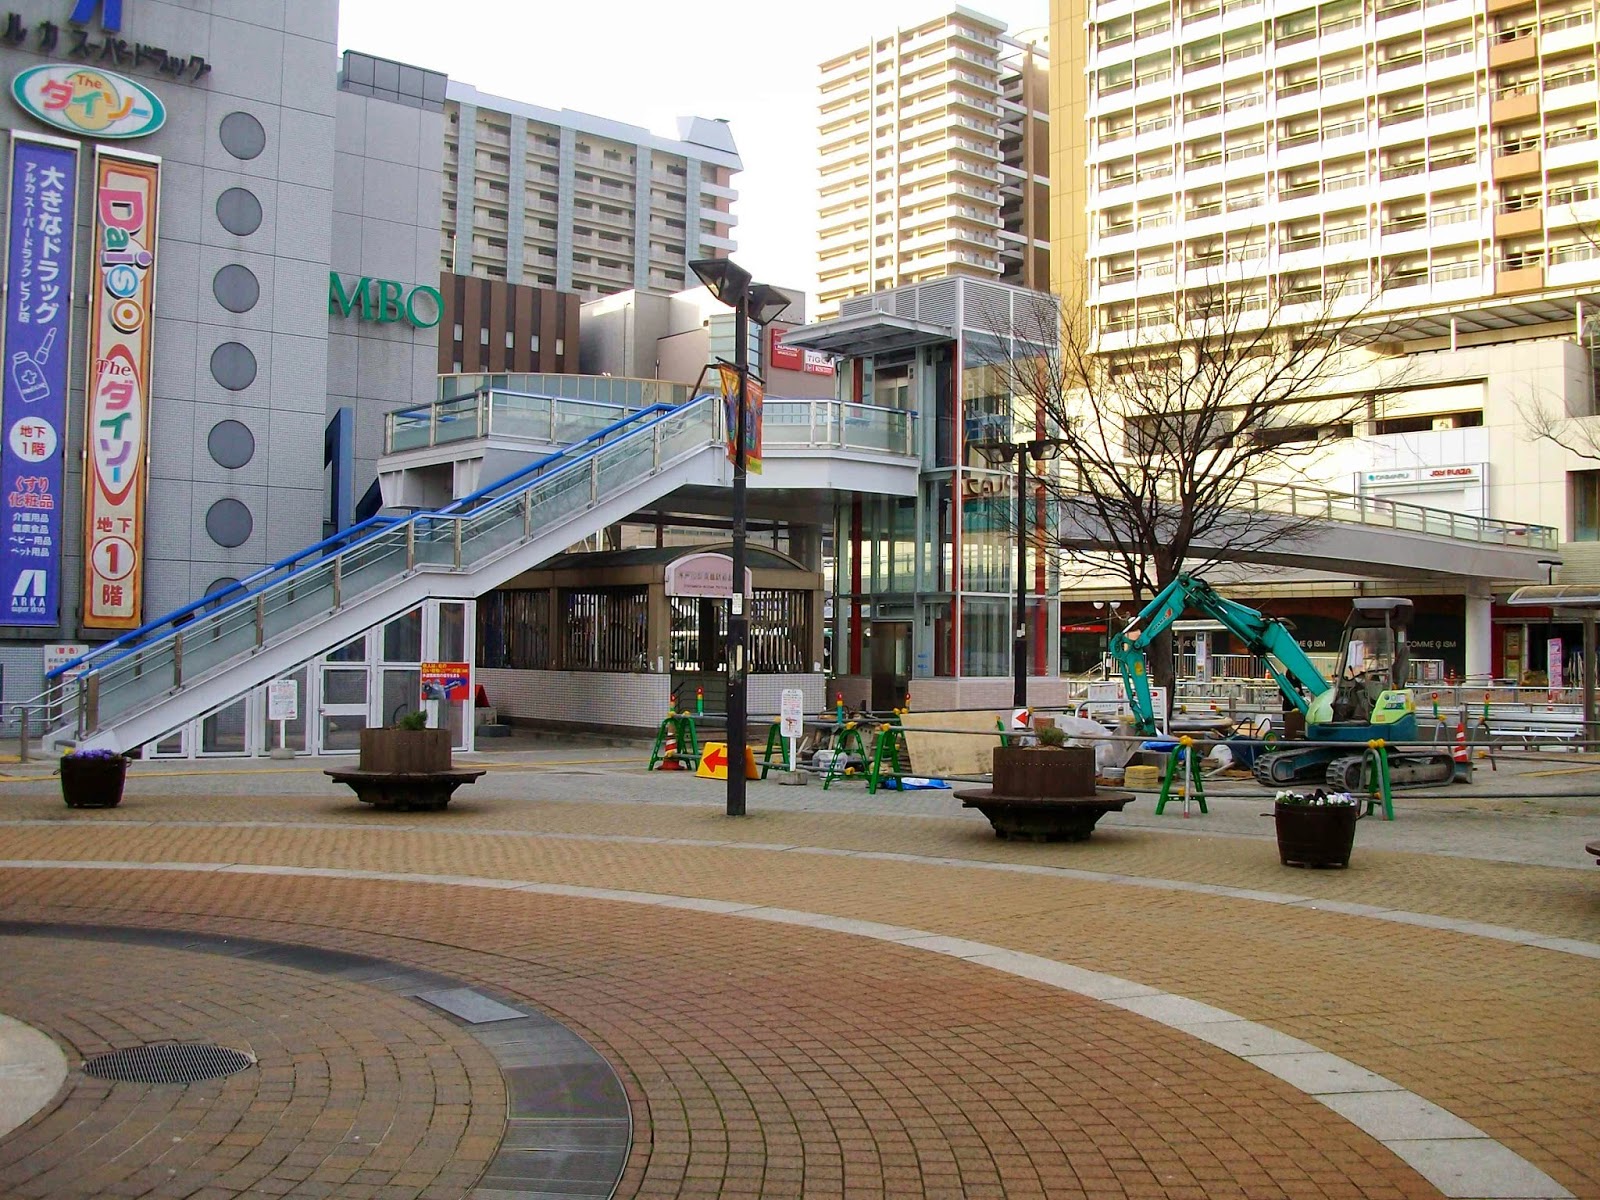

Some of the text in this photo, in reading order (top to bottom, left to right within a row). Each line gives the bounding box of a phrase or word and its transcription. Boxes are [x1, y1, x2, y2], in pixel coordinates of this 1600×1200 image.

[77, 75, 102, 89] The
[41, 80, 150, 119] ダイソー
[35, 165, 65, 324] 大きなドラッグ
[96, 359, 131, 376] The
[20, 425, 46, 438] 地下
[100, 379, 134, 483] ダイソー
[15, 476, 49, 493] くすり
[8, 492, 54, 509] 化粧品
[97, 517, 132, 533] 地下
[12, 597, 46, 606] ARKA
[102, 584, 122, 606] 階
